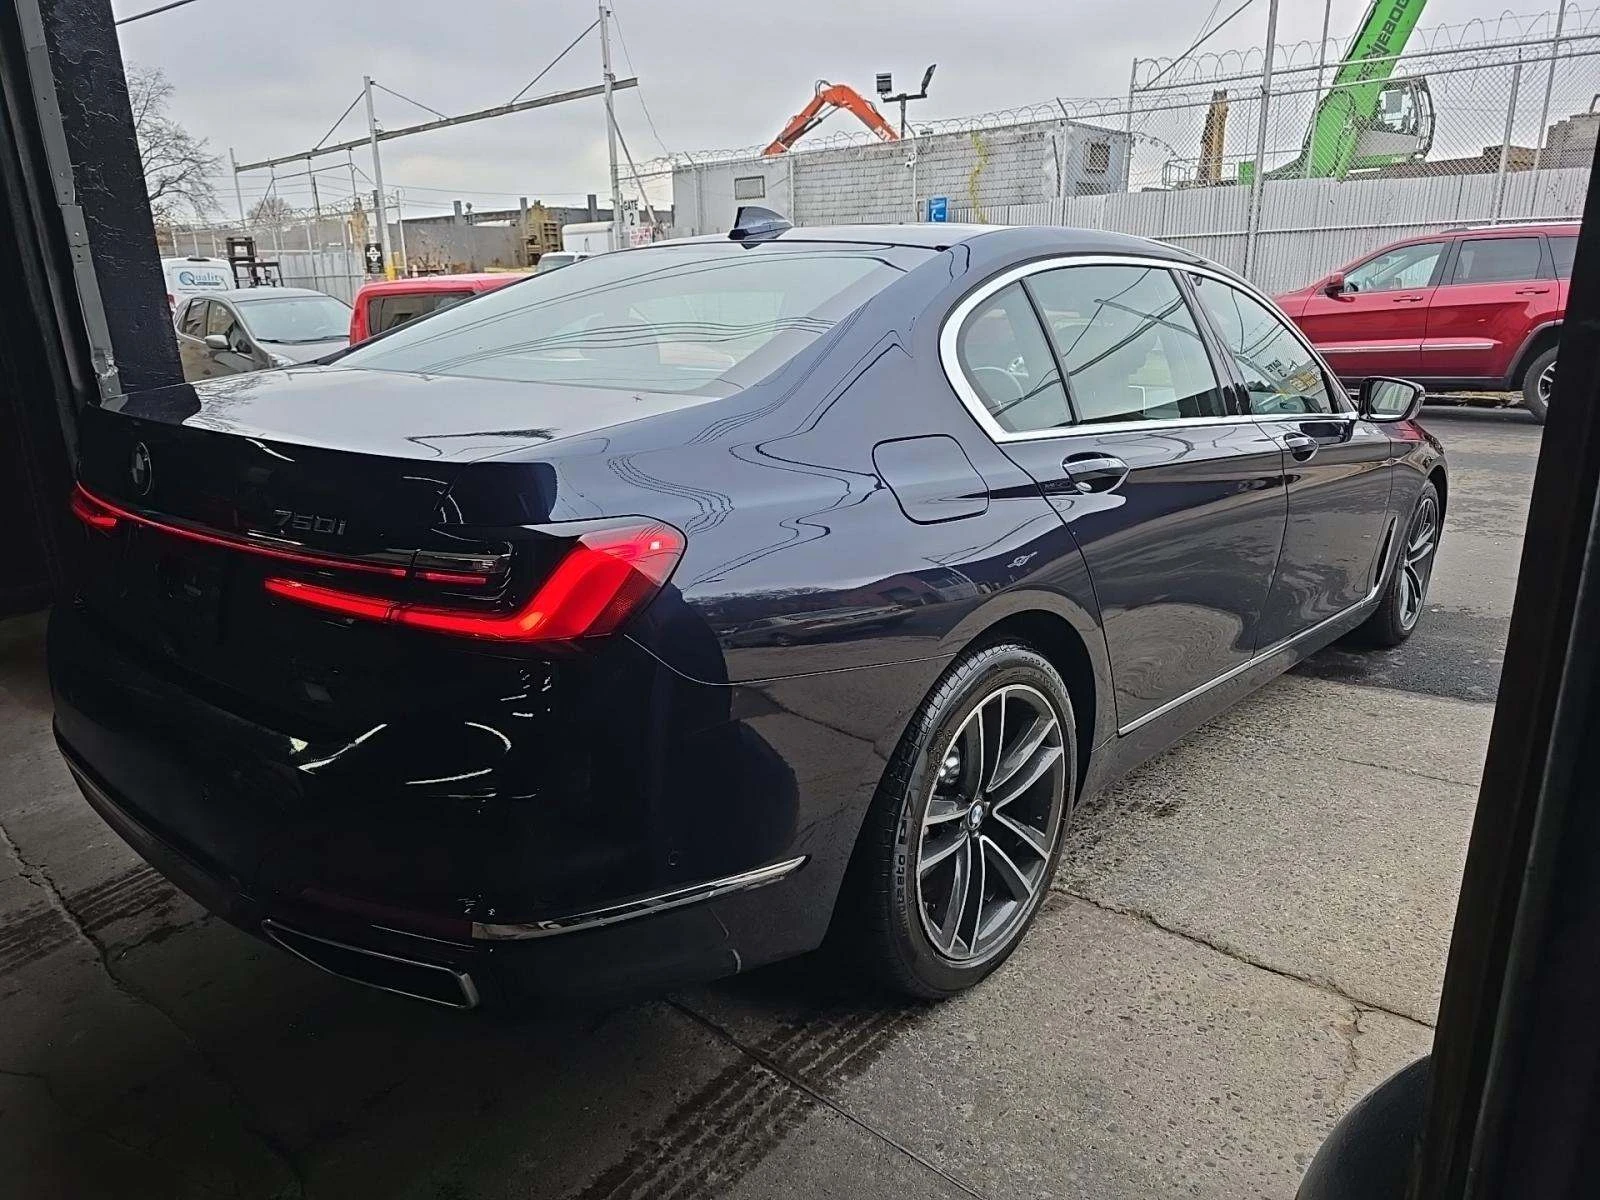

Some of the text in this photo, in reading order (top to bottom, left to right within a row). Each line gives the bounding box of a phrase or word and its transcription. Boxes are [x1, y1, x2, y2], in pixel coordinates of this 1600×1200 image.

[623, 199, 639, 210] GATE
[629, 212, 636, 226] 2
[273, 508, 347, 535] 750i
